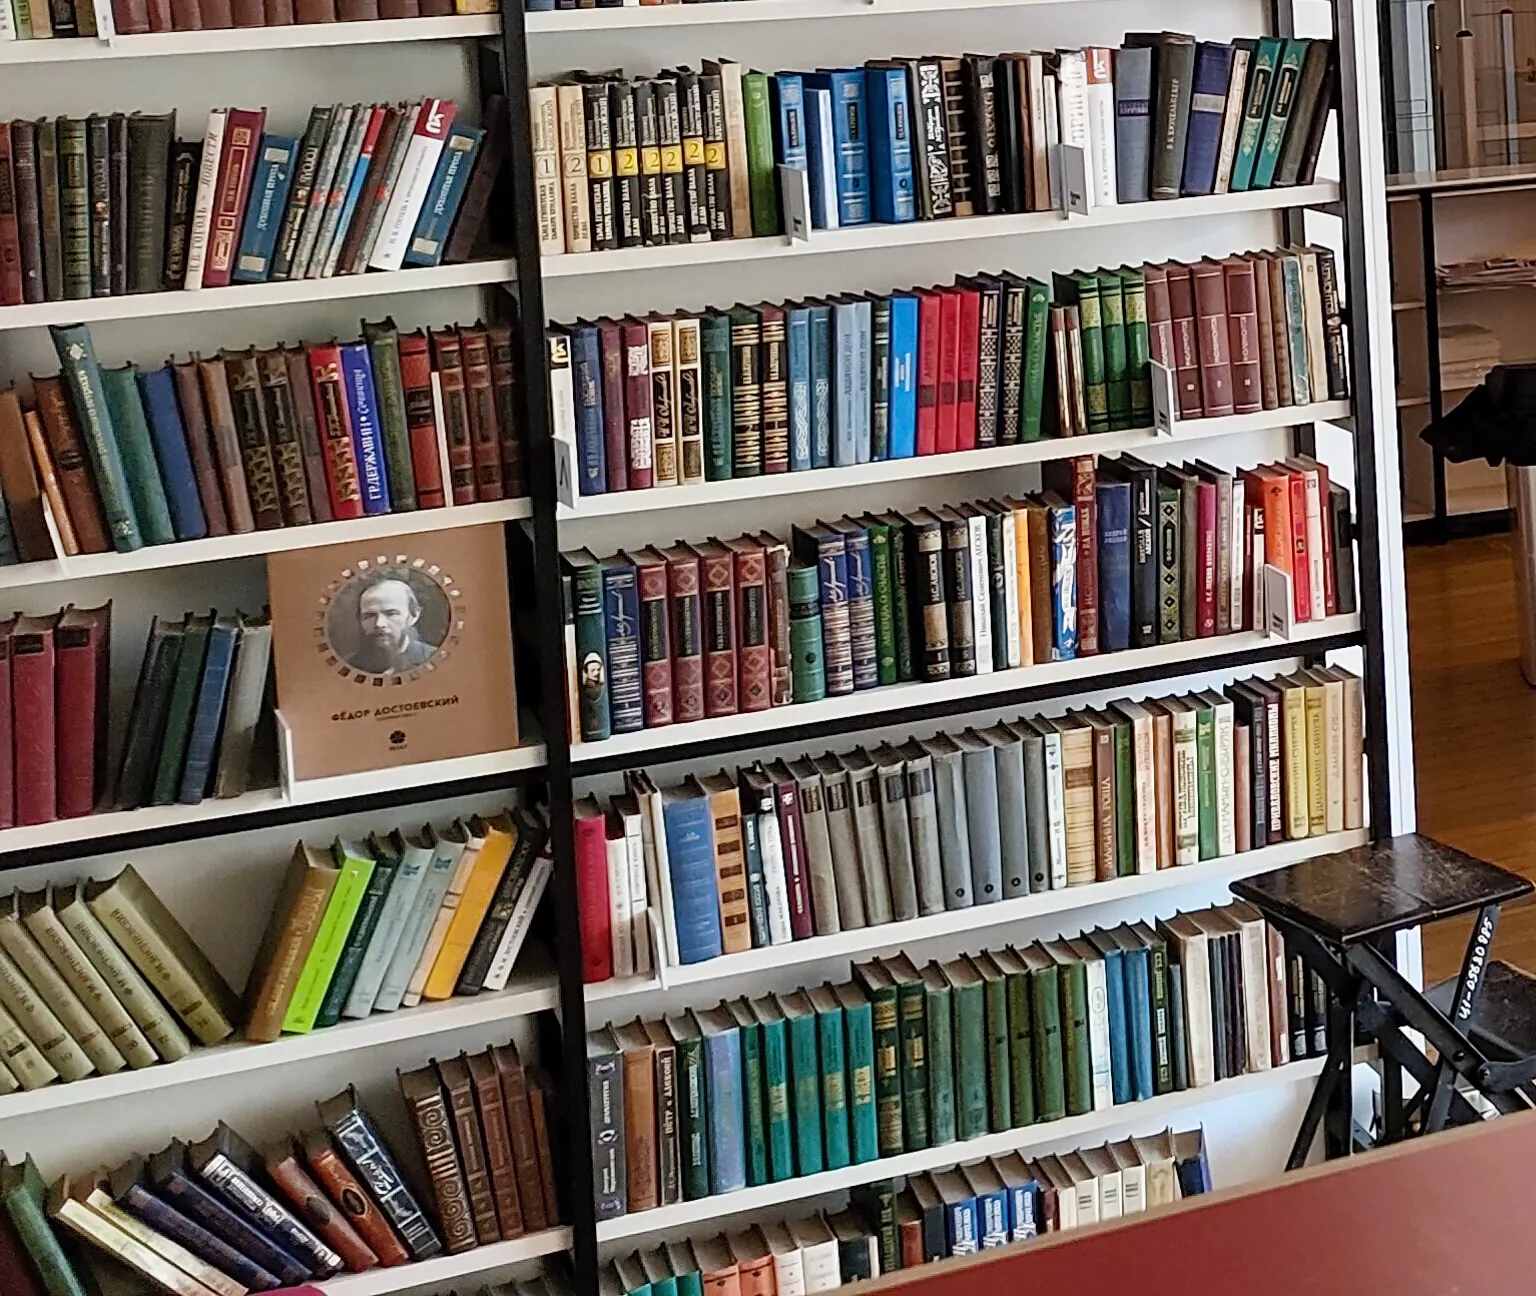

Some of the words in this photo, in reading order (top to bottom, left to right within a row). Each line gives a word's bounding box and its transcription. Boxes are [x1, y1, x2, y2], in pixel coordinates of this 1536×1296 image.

[192, 206, 206, 251] ГОГОЛЬ
[202, 132, 217, 188] ПОВЕСТИ
[975, 524, 984, 557] ЛЕСКОВ
[976, 559, 986, 602] Семенович
[978, 604, 988, 637] Николай
[331, 708, 370, 721] ФЁДОР
[374, 694, 459, 717] ДОСТОЕВСКИЙ
[660, 1056, 672, 1098] АЛЕКСЕЙ
[662, 1110, 674, 1134] ПЁТР
